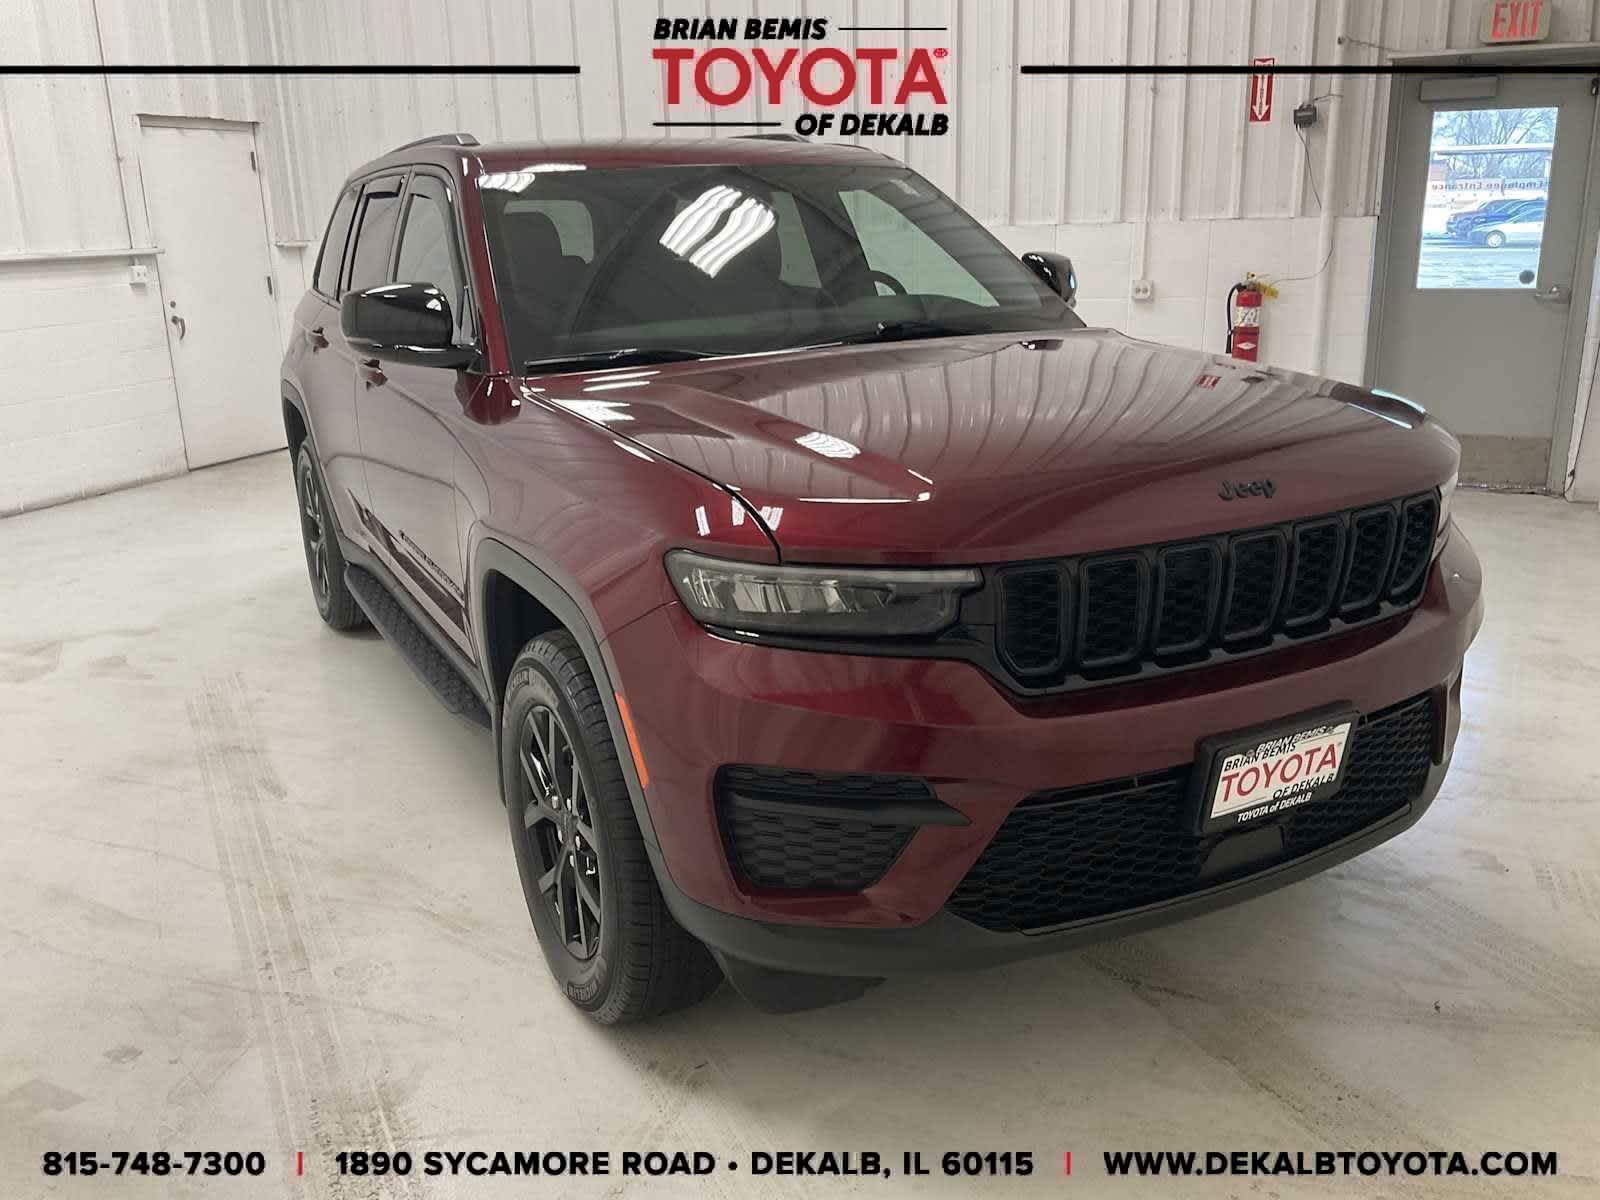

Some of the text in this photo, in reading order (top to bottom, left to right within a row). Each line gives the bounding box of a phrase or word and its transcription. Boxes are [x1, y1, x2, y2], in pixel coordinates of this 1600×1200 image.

[1492, 0, 1543, 39] EXIT
[1218, 479, 1276, 501] Jeep
[1257, 725, 1327, 753] BRIAN BEMIS
[1221, 743, 1337, 801] TOYOTA
[1224, 742, 1297, 772] BRIAN BEMIS
[1272, 773, 1335, 800] OF DEKALB
[1237, 791, 1312, 823] TOYOTA of DEKALB
